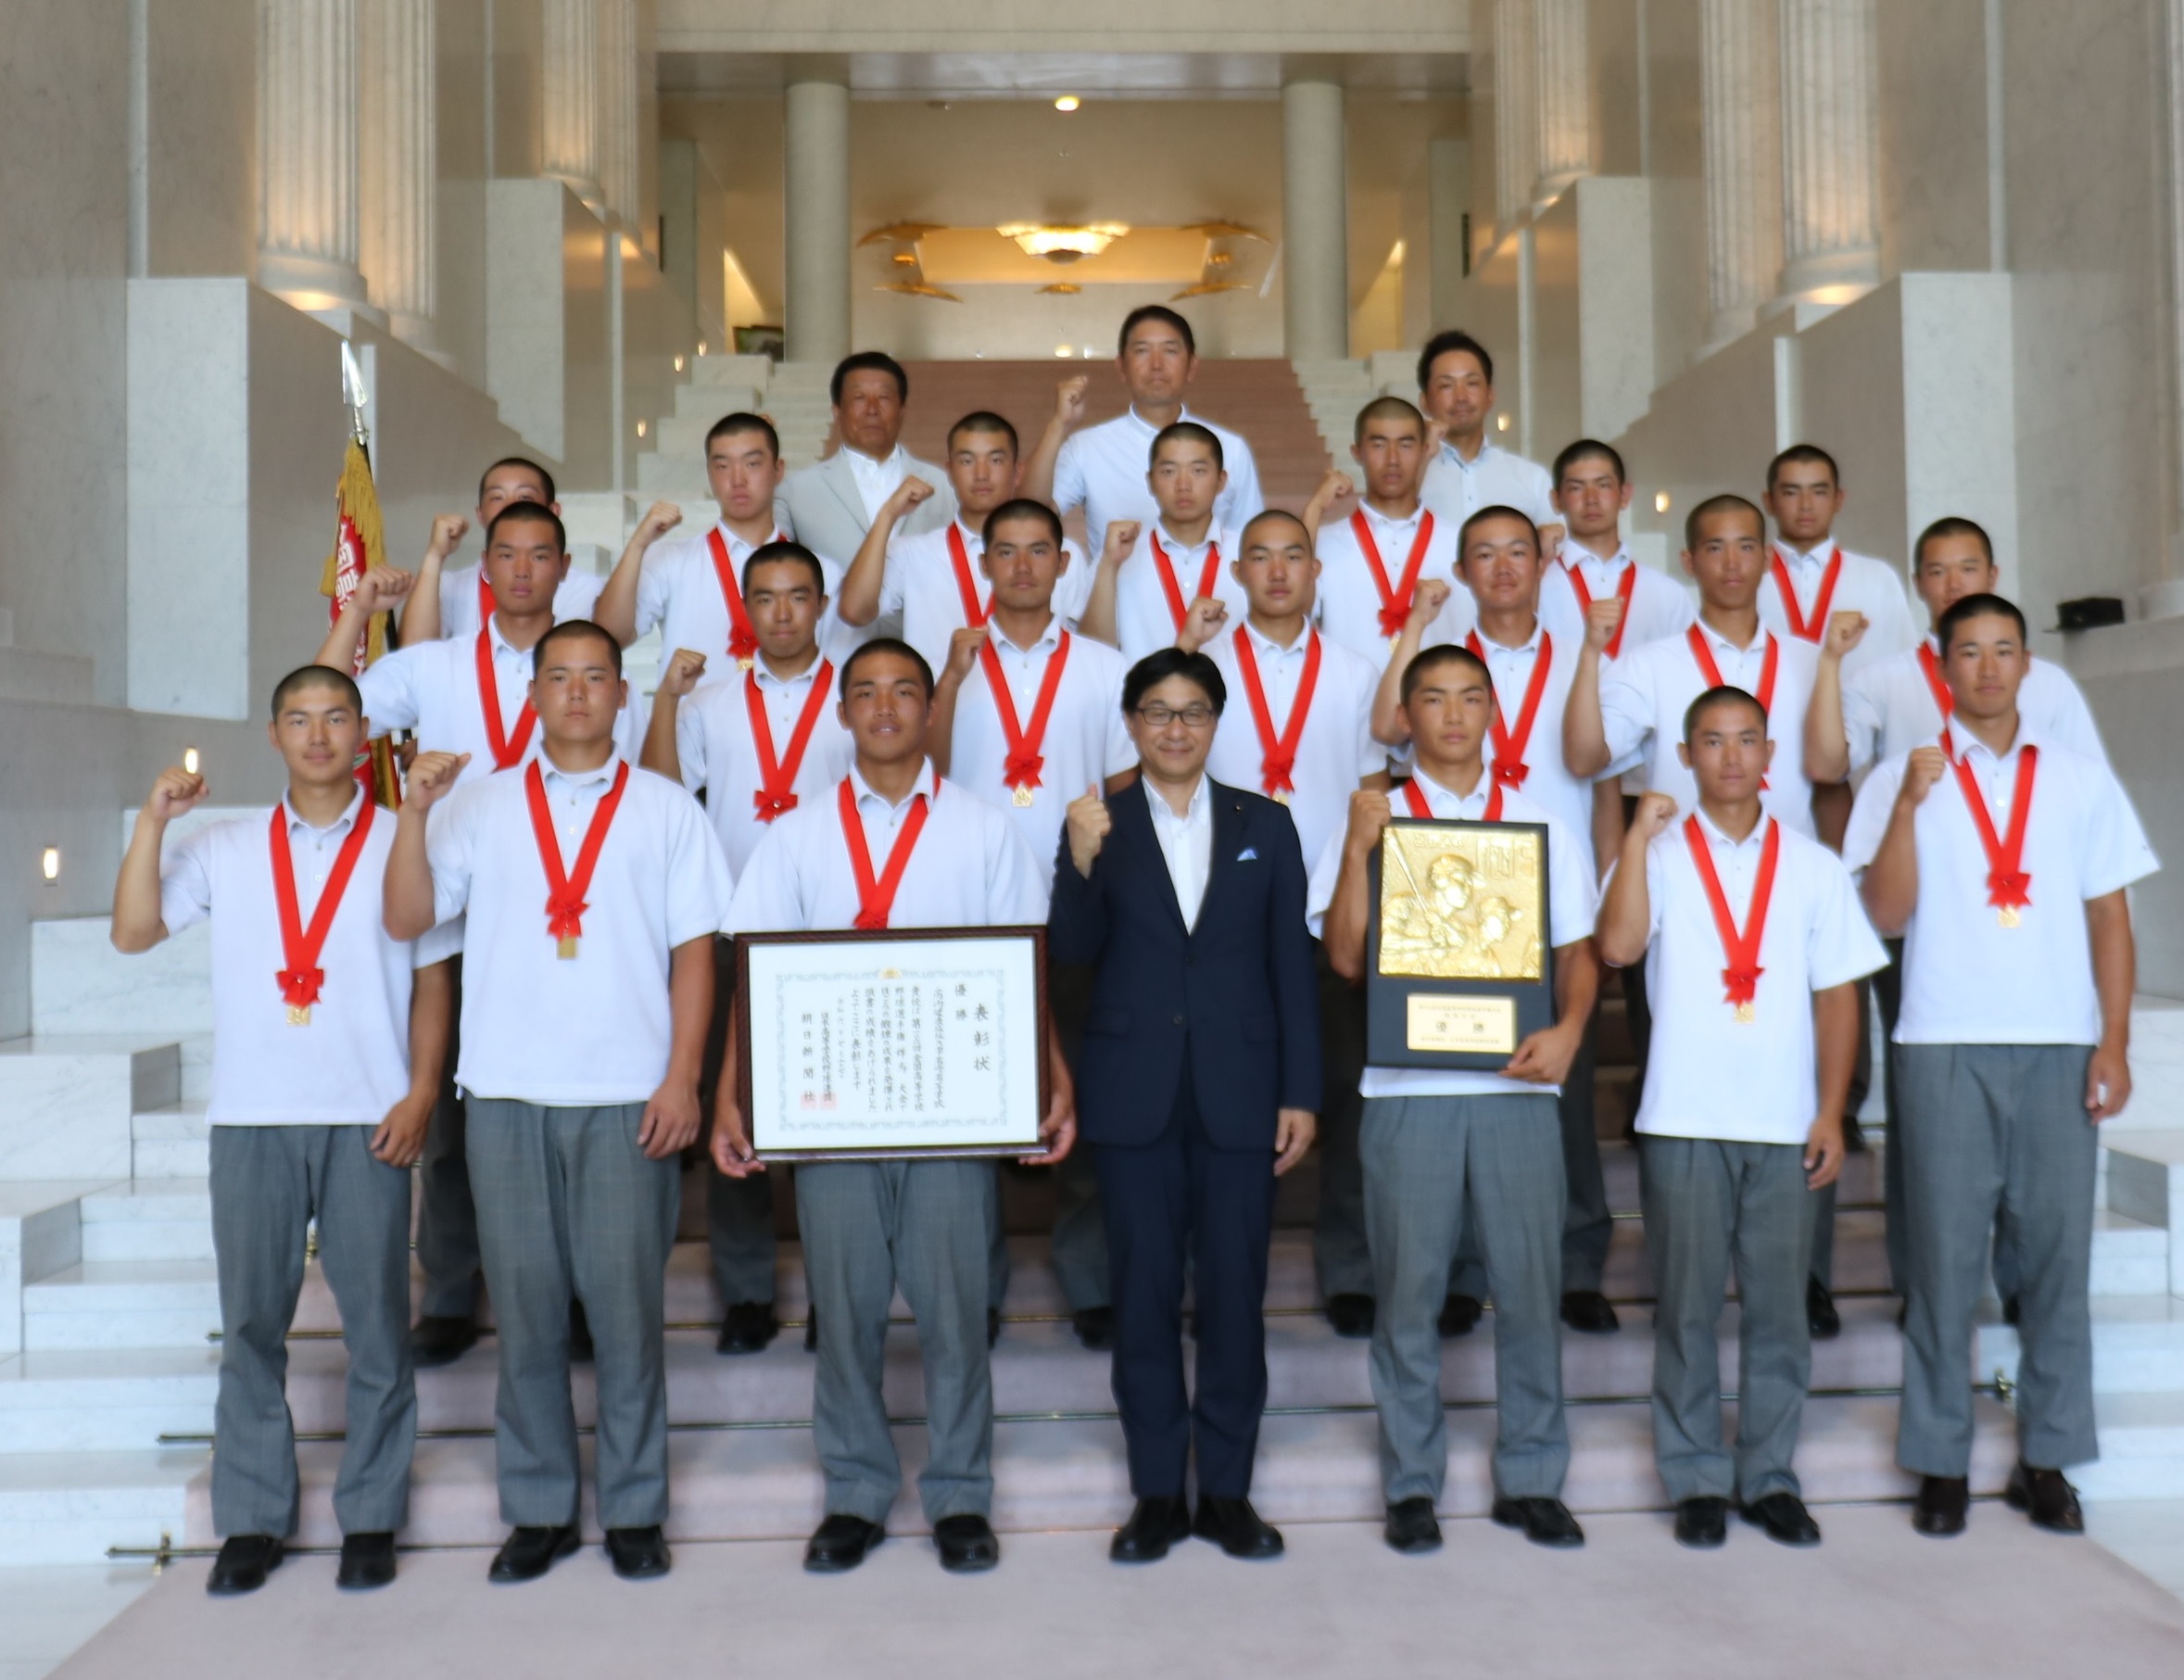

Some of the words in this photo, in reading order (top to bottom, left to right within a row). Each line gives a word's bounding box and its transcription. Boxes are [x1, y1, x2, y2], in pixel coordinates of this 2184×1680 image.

[954, 983, 967, 1021] 優勝
[801, 1012, 814, 1102] 朝日新聞社
[973, 1003, 991, 1071] 表彰状
